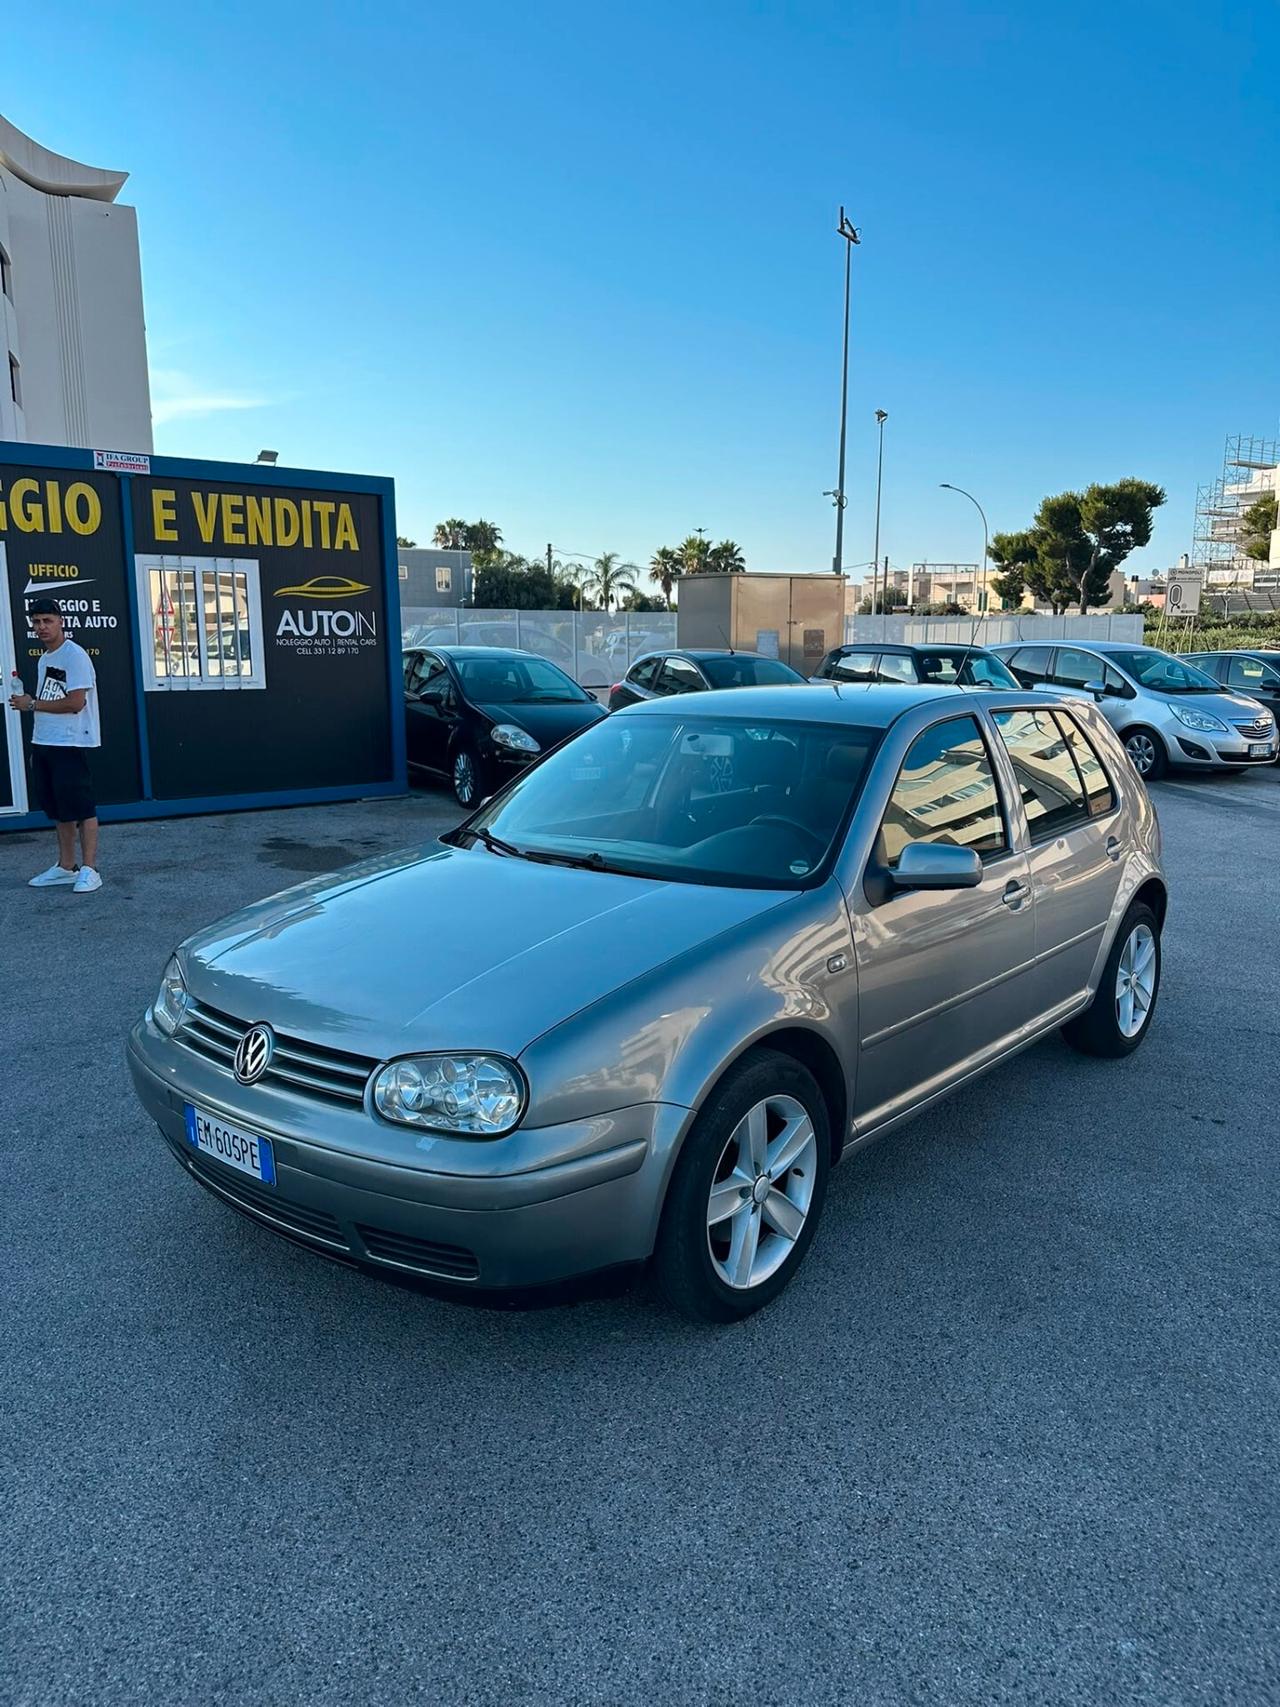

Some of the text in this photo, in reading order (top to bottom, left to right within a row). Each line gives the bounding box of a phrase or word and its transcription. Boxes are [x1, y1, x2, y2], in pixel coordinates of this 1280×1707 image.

[120, 455, 149, 463] GROUP
[0, 477, 102, 536] GIO
[151, 488, 360, 551] E VENDITA
[28, 563, 79, 578] UFFICIO
[92, 599, 101, 612] E
[84, 615, 118, 629] AUTO
[276, 609, 377, 637] AUTOIN
[276, 638, 377, 647] NOLEGGIO AUTO RENTAL CARS
[296, 647, 360, 656] CELL 331 12 89 170
